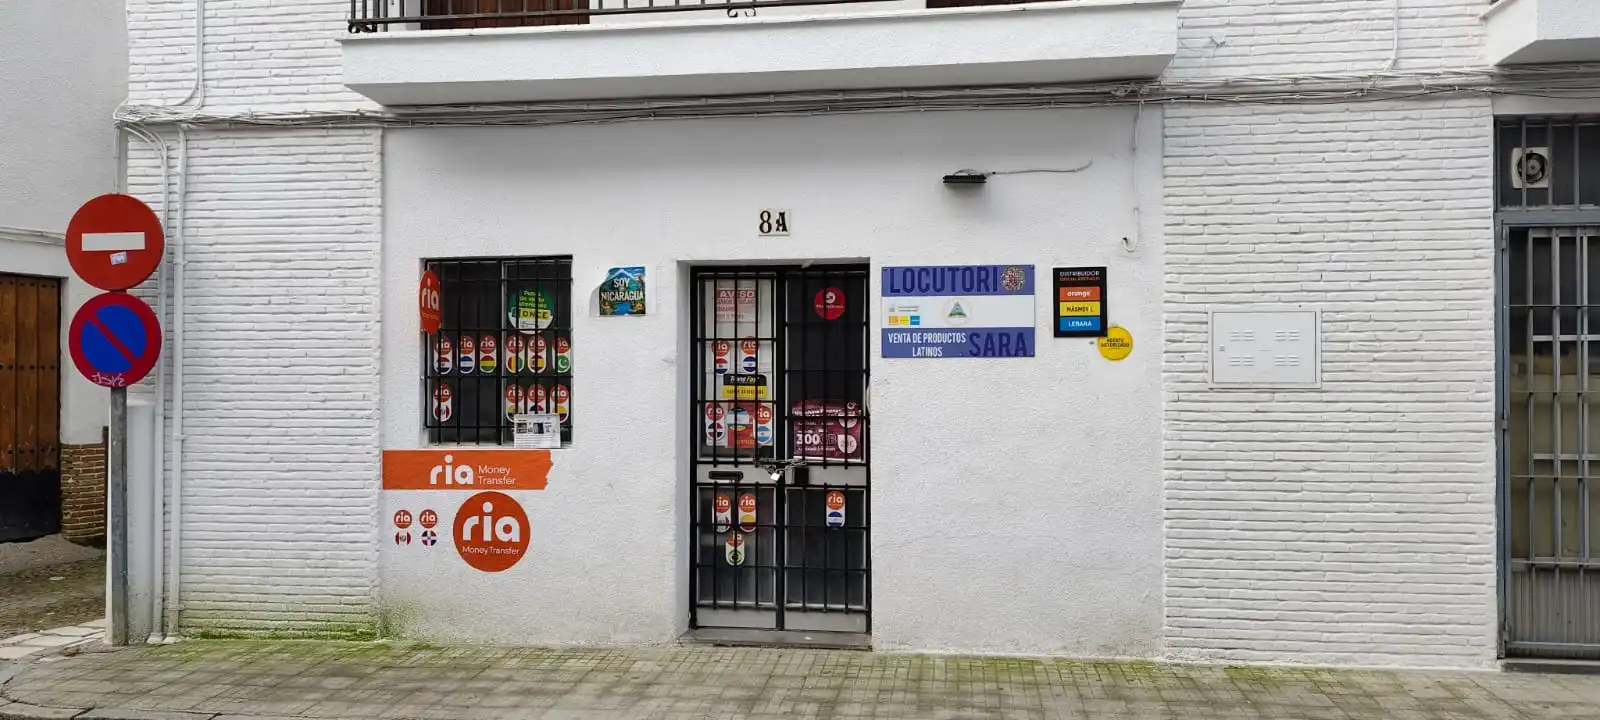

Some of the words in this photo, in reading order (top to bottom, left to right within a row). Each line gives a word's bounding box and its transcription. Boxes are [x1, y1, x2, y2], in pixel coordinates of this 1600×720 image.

[613, 277, 630, 288] SOY
[421, 278, 440, 311] ria
[600, 290, 645, 302] NICARAGUA
[720, 290, 755, 298] AVSO
[480, 337, 495, 348] ria
[529, 339, 545, 347] ra
[888, 332, 911, 344] VENTA
[912, 332, 922, 344] DE
[923, 332, 967, 344] PRODUCTOS
[968, 332, 1028, 357] SARA
[912, 346, 943, 357] LATINOS
[529, 388, 544, 397] ra
[707, 405, 723, 415] ra
[430, 454, 475, 485] ria
[478, 464, 510, 476] Money
[478, 476, 516, 486] Transfer
[741, 496, 756, 506] ria
[828, 493, 843, 504] ria
[395, 511, 411, 523] ria
[421, 511, 436, 523] ria
[462, 501, 521, 543] ria
[462, 545, 488, 556] Money
[489, 546, 520, 556] Transfer
